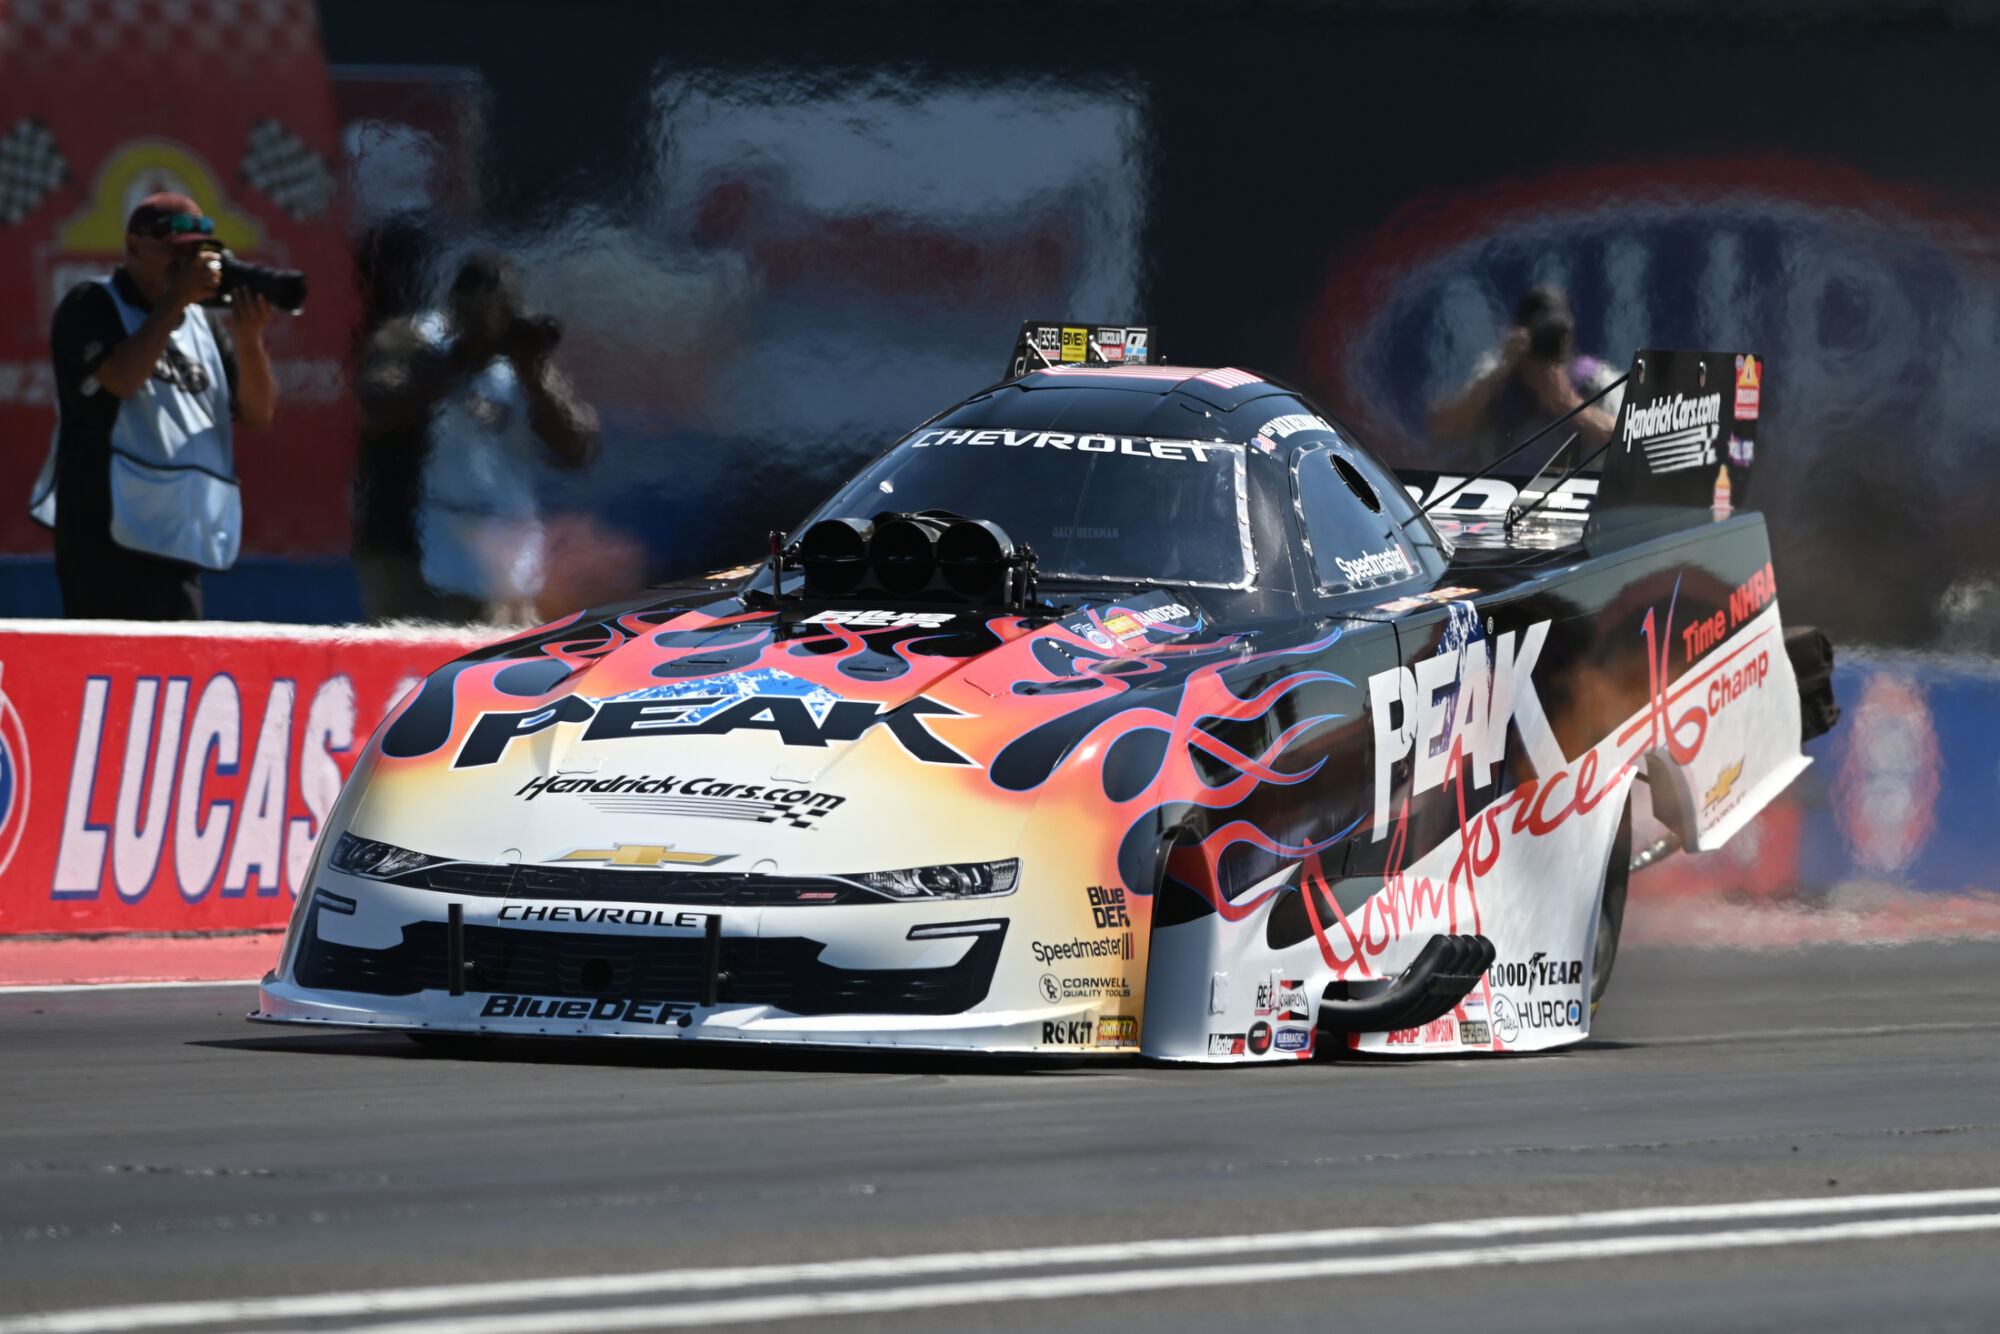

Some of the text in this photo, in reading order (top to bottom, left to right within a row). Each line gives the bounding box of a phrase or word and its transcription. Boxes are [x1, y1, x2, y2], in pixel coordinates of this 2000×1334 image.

[912, 430, 1208, 462] CHEVROLET
[1132, 603, 1190, 626] BANDERO
[1682, 610, 1726, 662] Time
[1729, 562, 1777, 630] NHRA
[1708, 649, 1769, 717] Champ
[450, 692, 982, 772] PEAK
[1368, 619, 1568, 842] PEAK
[51, 672, 357, 905] LUCAS
[1087, 886, 1126, 906] Blue
[1302, 797, 1446, 982] John
[1092, 904, 1131, 929] DEF
[1032, 937, 1122, 966] Speedmaster
[1063, 978, 1129, 989] CORNWELL
[1063, 989, 1131, 998] QUALITY TOOLS
[480, 995, 697, 1026] BlueDEF
[1280, 992, 1306, 1008] CHAMPION
[1517, 999, 1582, 1030] HURCO
[1425, 1018, 1455, 1043] SIMPSON
